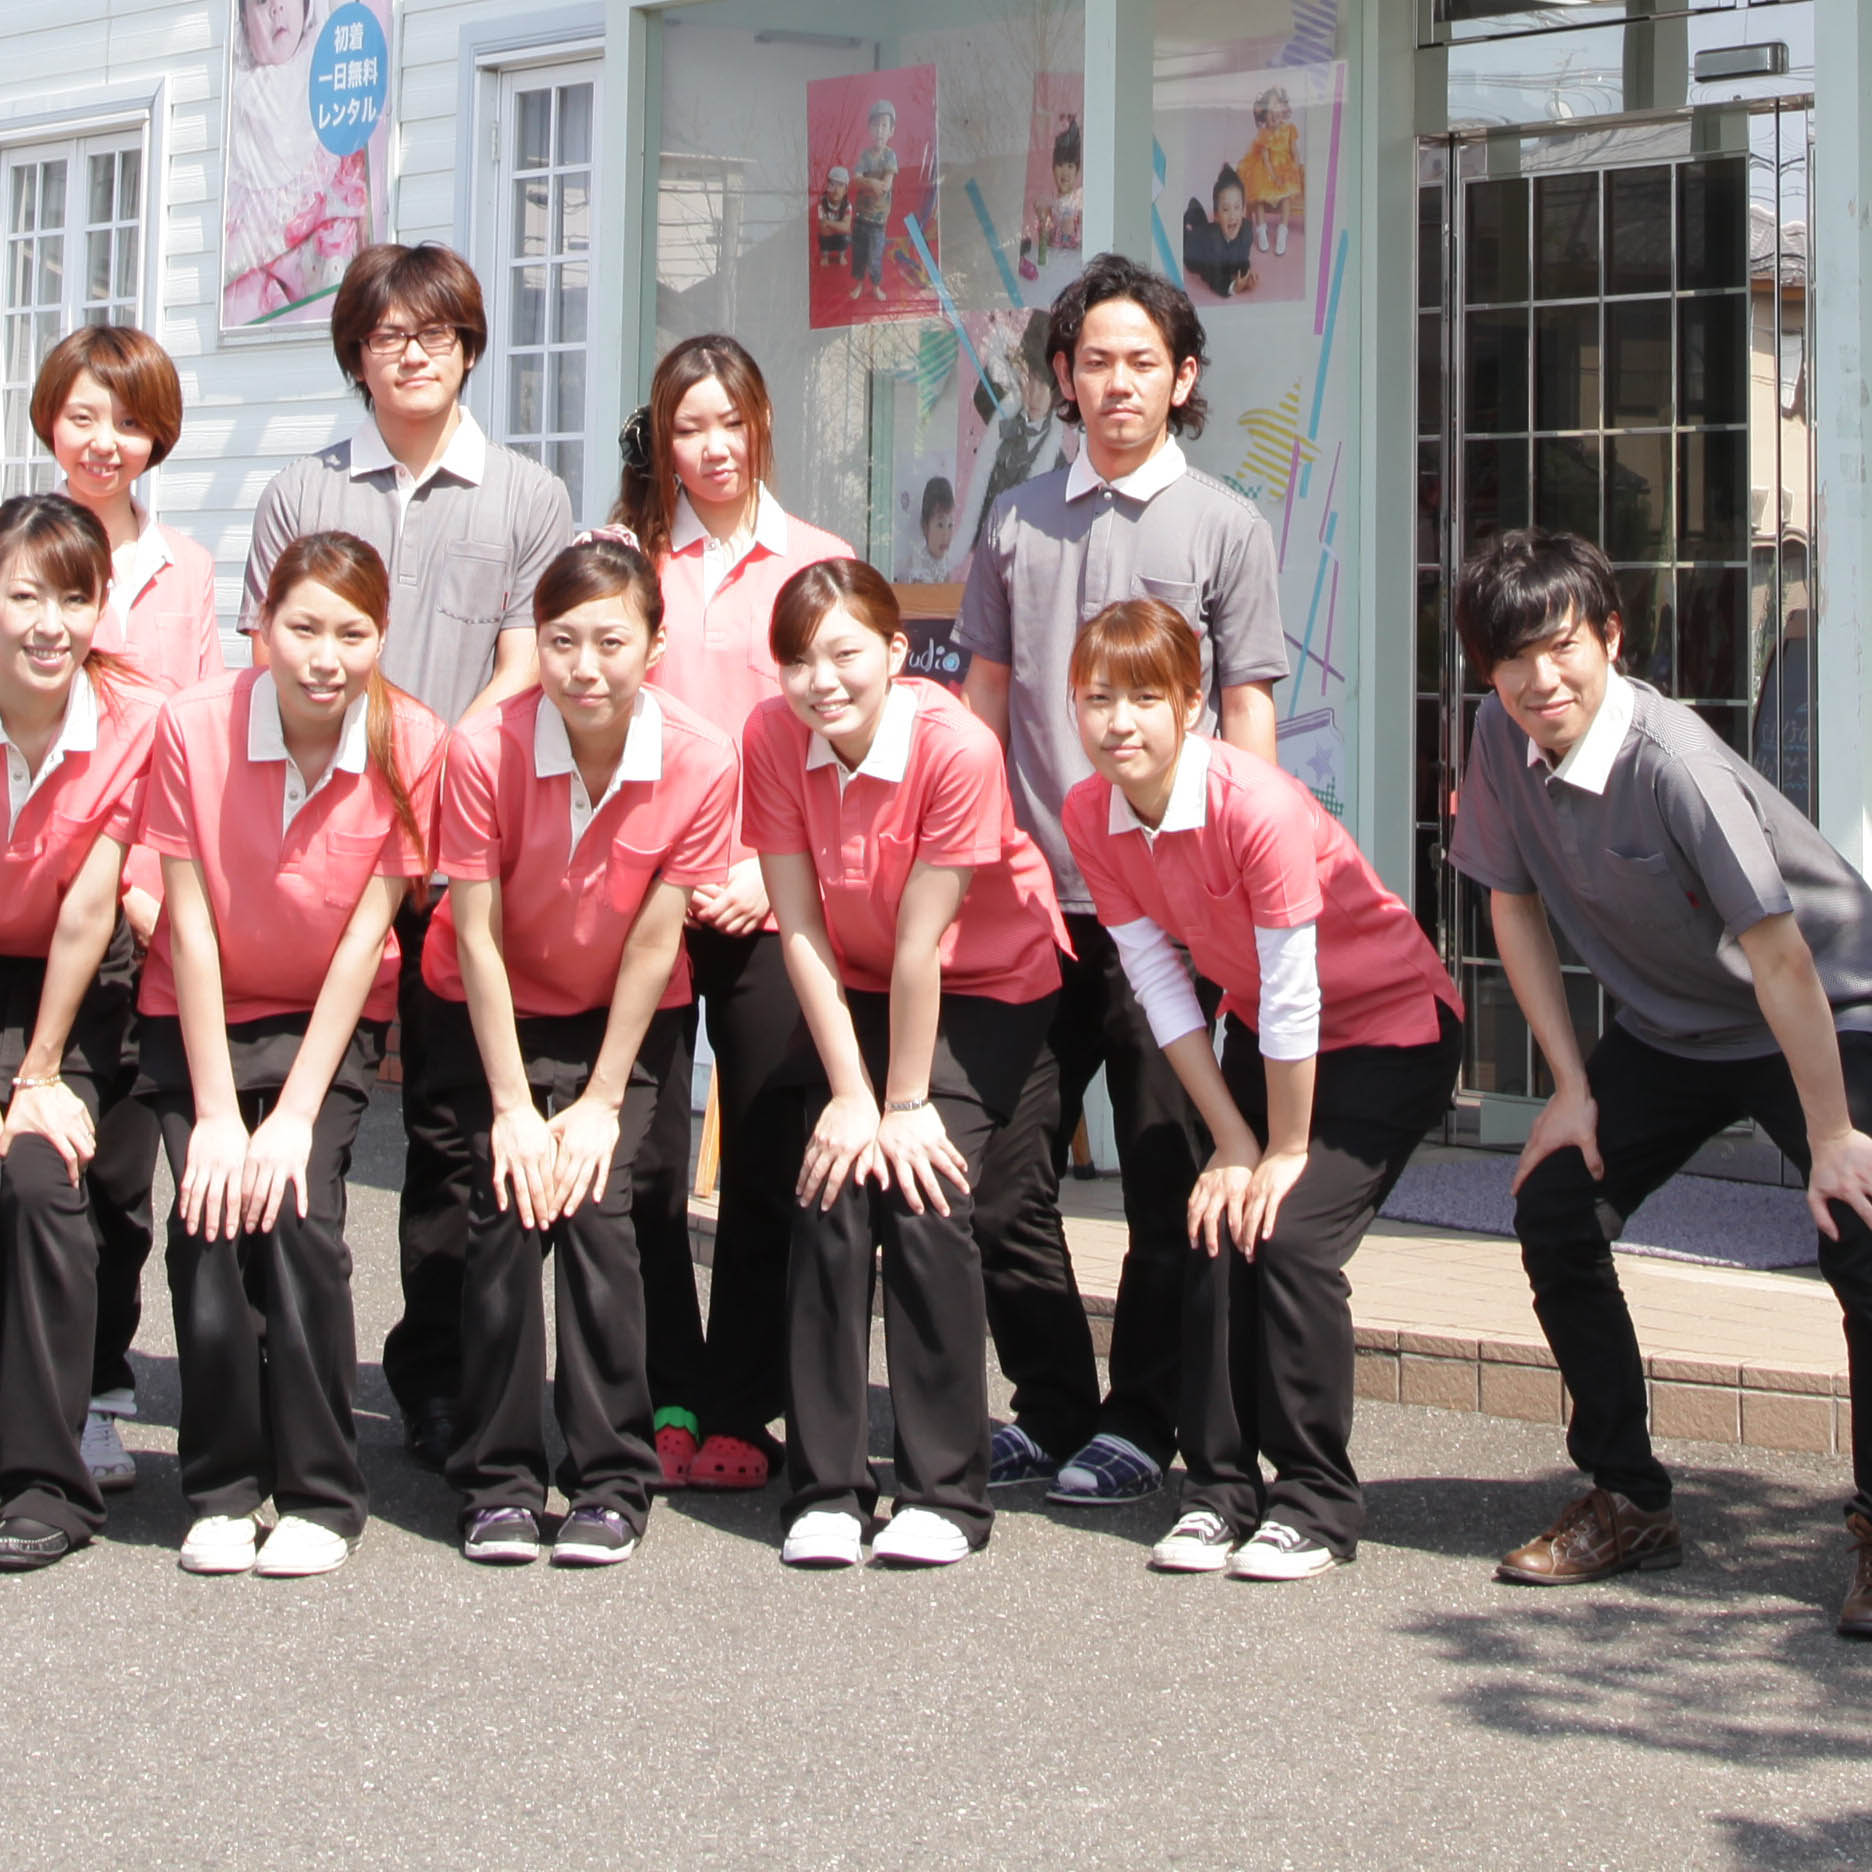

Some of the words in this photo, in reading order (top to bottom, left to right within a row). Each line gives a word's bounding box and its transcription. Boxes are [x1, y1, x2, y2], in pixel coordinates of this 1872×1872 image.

[333, 21, 364, 52] 初着
[318, 60, 379, 93] 一日無料
[317, 94, 378, 128] レンタル
[908, 637, 960, 673] udio
